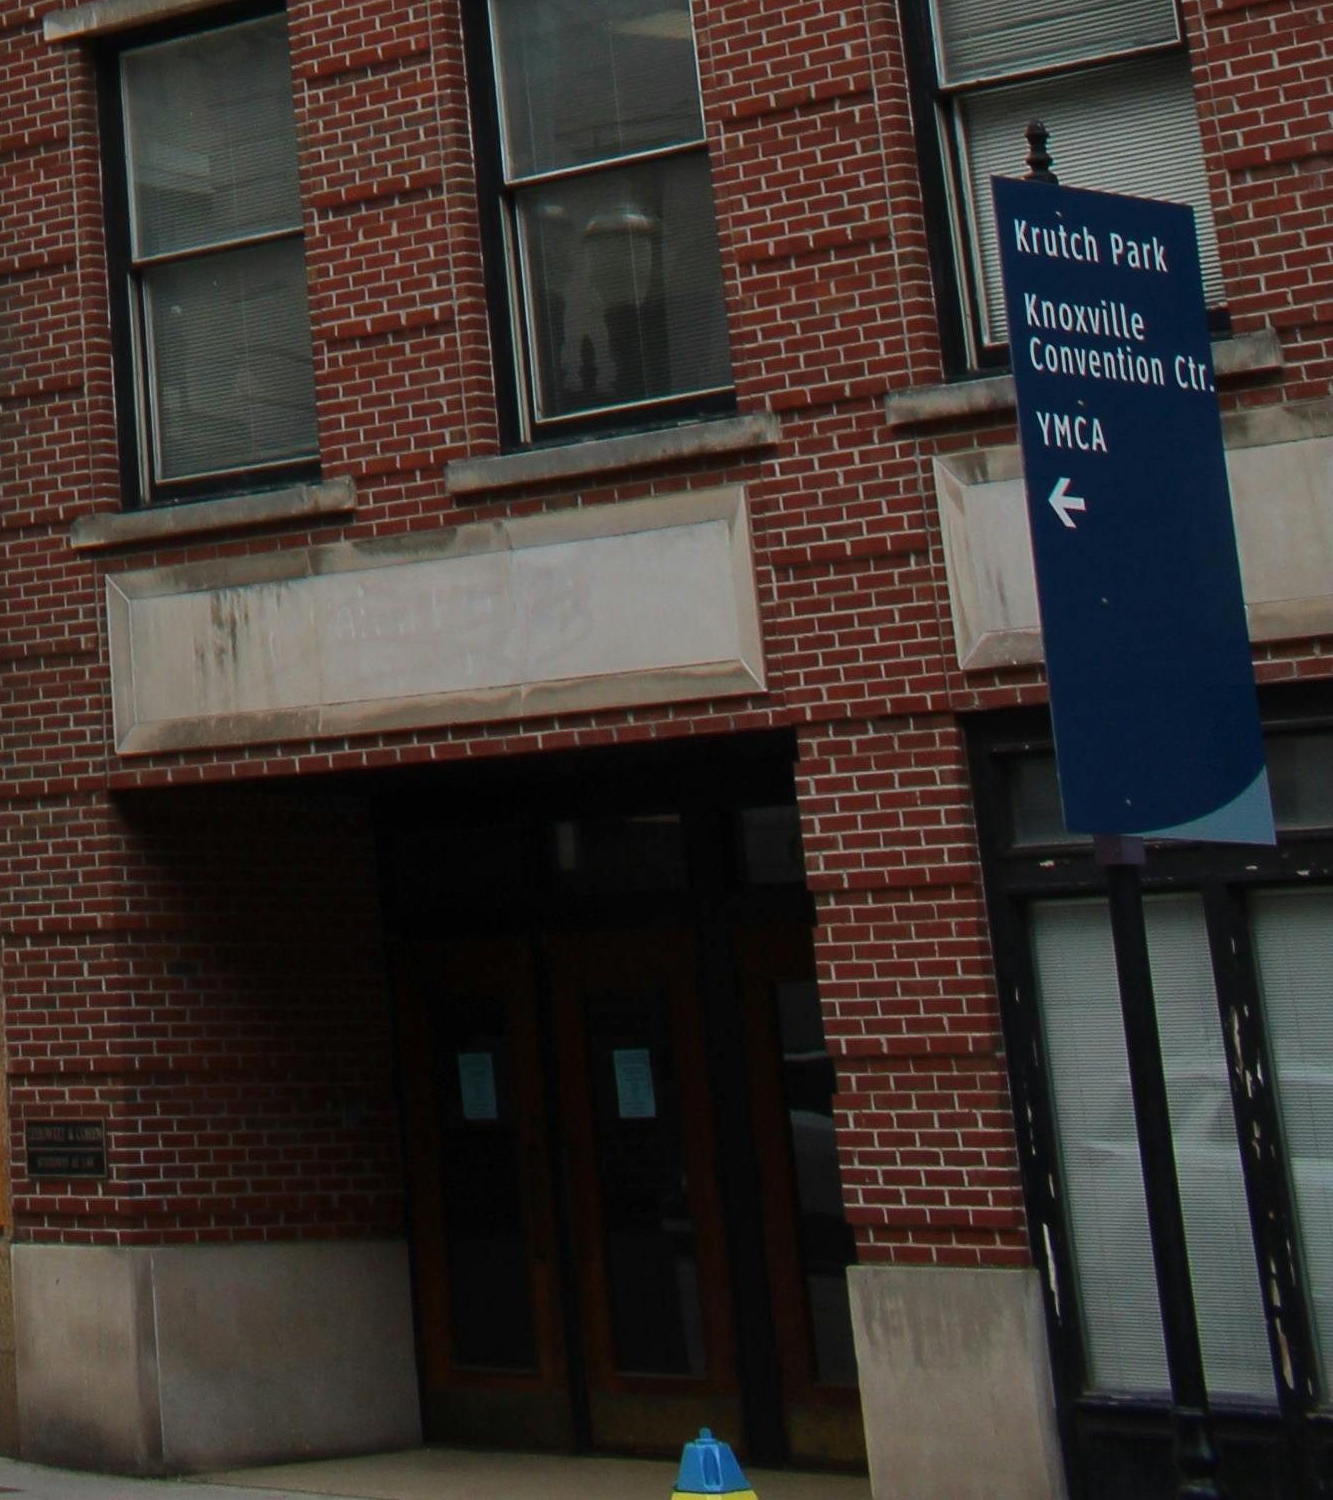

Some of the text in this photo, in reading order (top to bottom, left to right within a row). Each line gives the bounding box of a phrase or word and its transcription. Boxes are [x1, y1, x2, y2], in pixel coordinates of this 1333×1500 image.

[1014, 217, 1167, 274] Krutch Park
[1024, 292, 1145, 342] Knoxville
[1030, 337, 1215, 393] Convention Ctr.
[1036, 412, 1107, 453] YMCA
